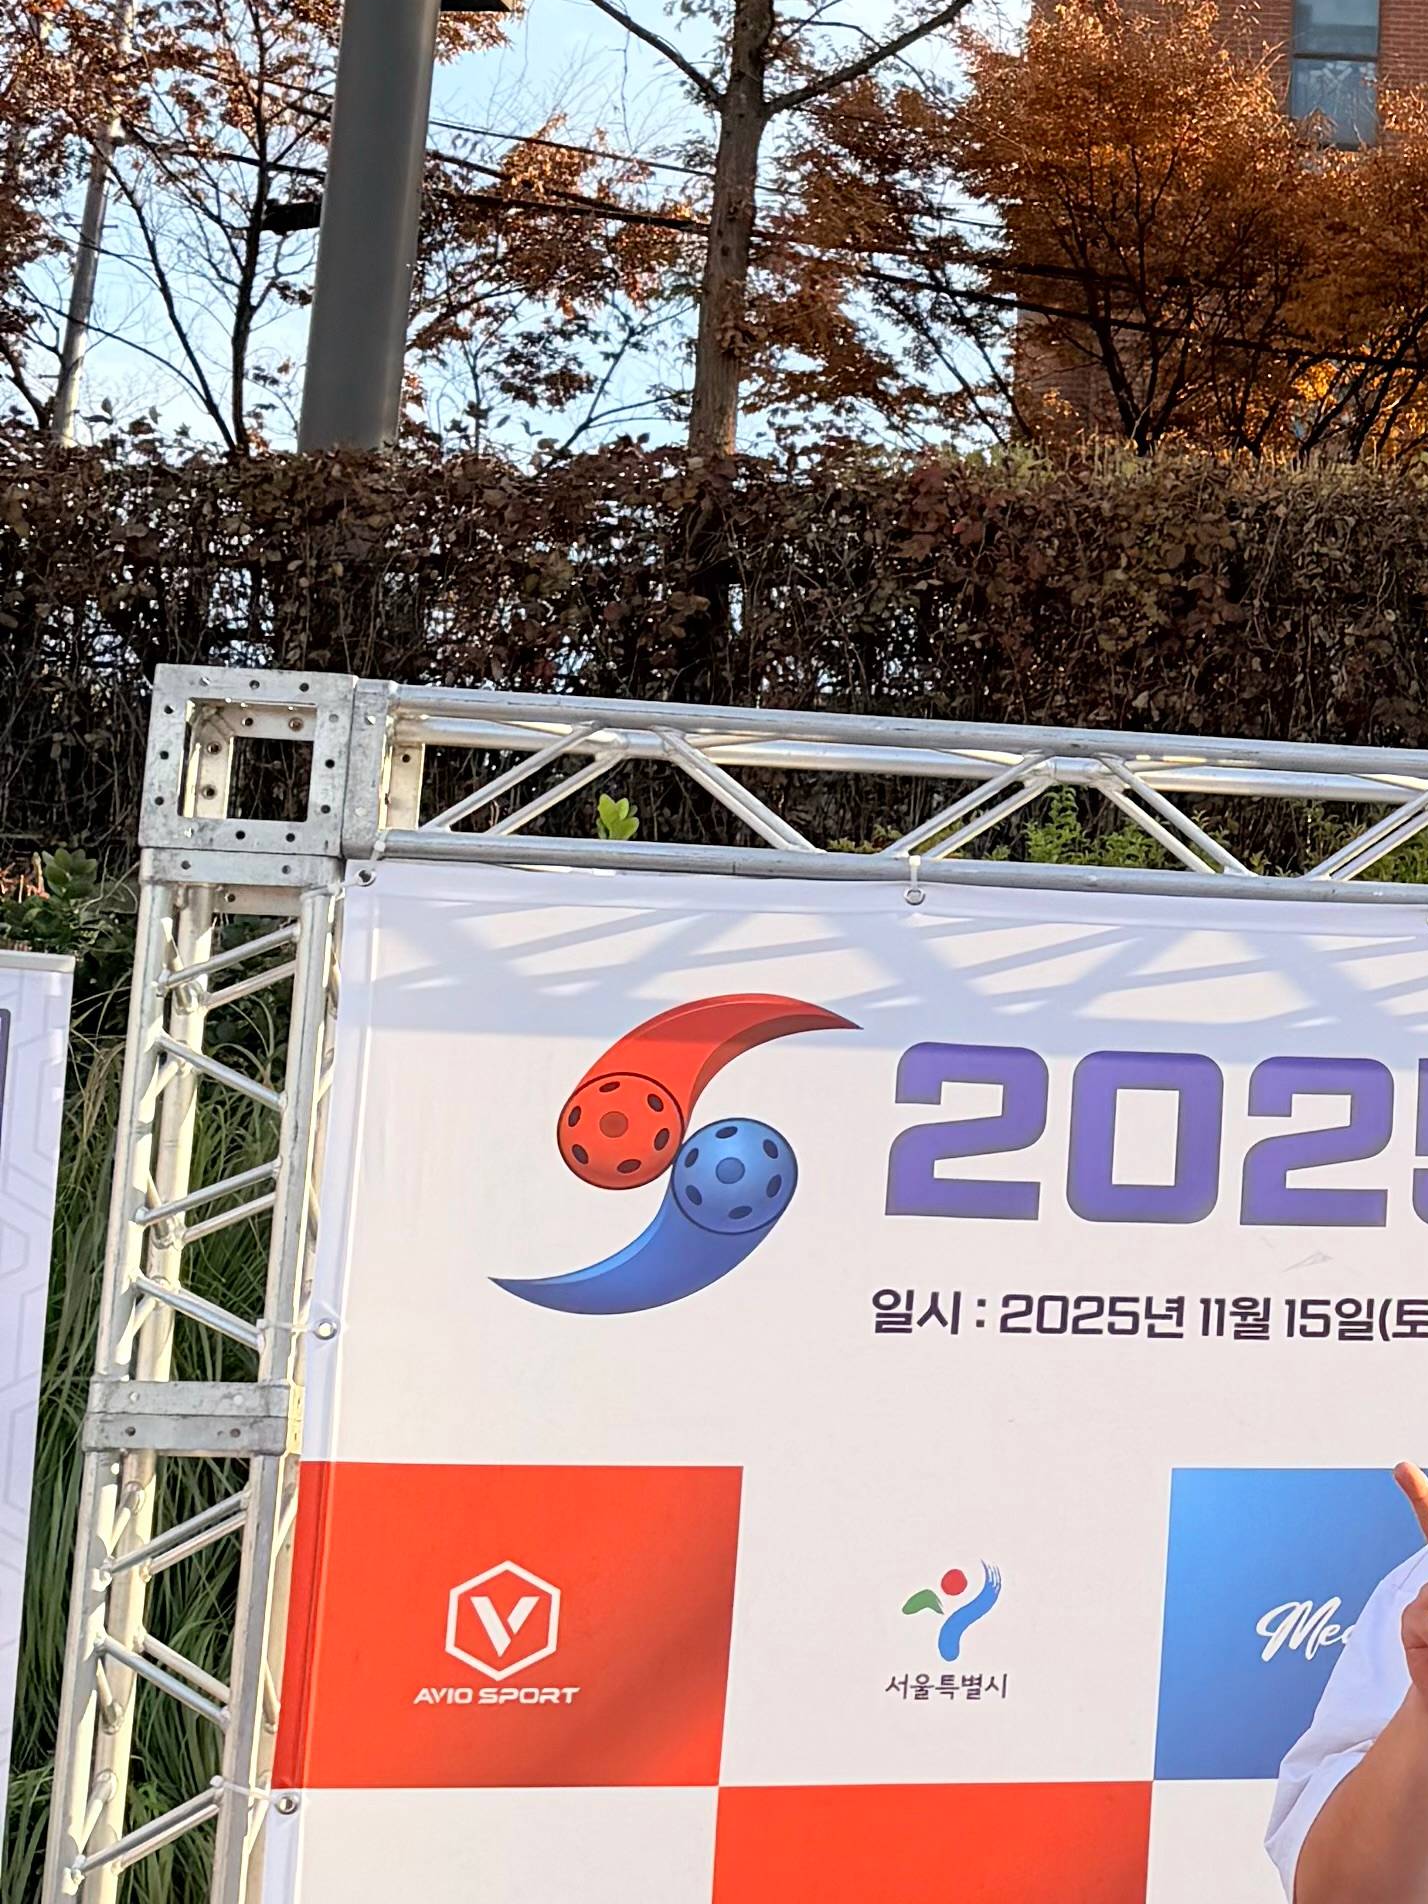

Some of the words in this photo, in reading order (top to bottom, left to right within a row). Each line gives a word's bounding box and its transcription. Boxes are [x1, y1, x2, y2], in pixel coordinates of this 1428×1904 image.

[871, 1288, 961, 1336] 일시
[1000, 1294, 1186, 1339] 2025년
[1200, 1295, 1272, 1341] 11월
[413, 1686, 473, 1706] AVIO
[478, 1685, 581, 1705] SPORT
[885, 1672, 1010, 1702] 서울특별시
